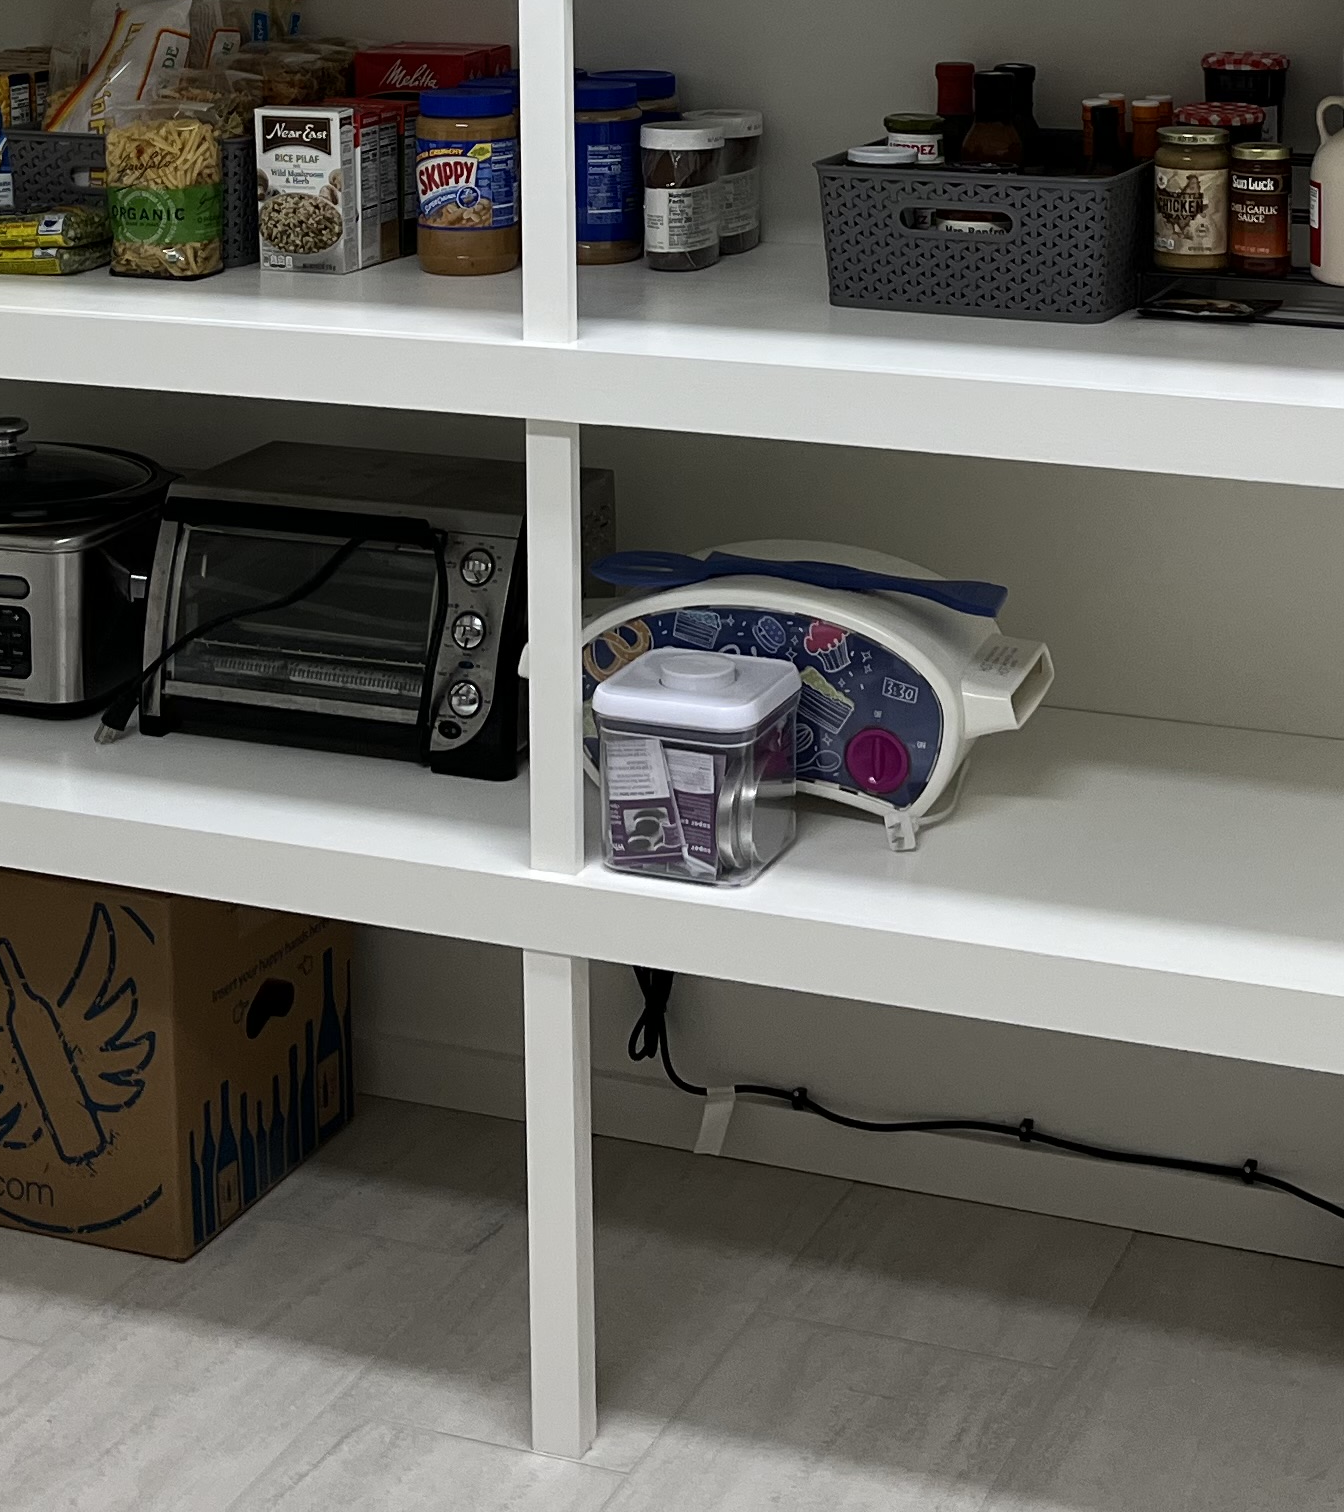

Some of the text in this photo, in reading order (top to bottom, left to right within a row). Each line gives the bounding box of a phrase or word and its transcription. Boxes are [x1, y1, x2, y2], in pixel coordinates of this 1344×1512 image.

[379, 58, 440, 90] Melitta
[266, 122, 328, 142] Near East
[274, 153, 320, 164] RICE PILAF
[292, 177, 310, 185] Herb
[418, 161, 474, 196] SKIPPY
[1232, 175, 1275, 191] Sun Luck
[112, 203, 185, 222] ORGANIC
[1158, 199, 1204, 214] CHICKEN
[1246, 205, 1278, 215] GARLIC
[1237, 213, 1266, 224] SAUCE
[885, 680, 914, 701] 3:30
[258, 947, 284, 974] happy
[284, 930, 310, 954] hands
